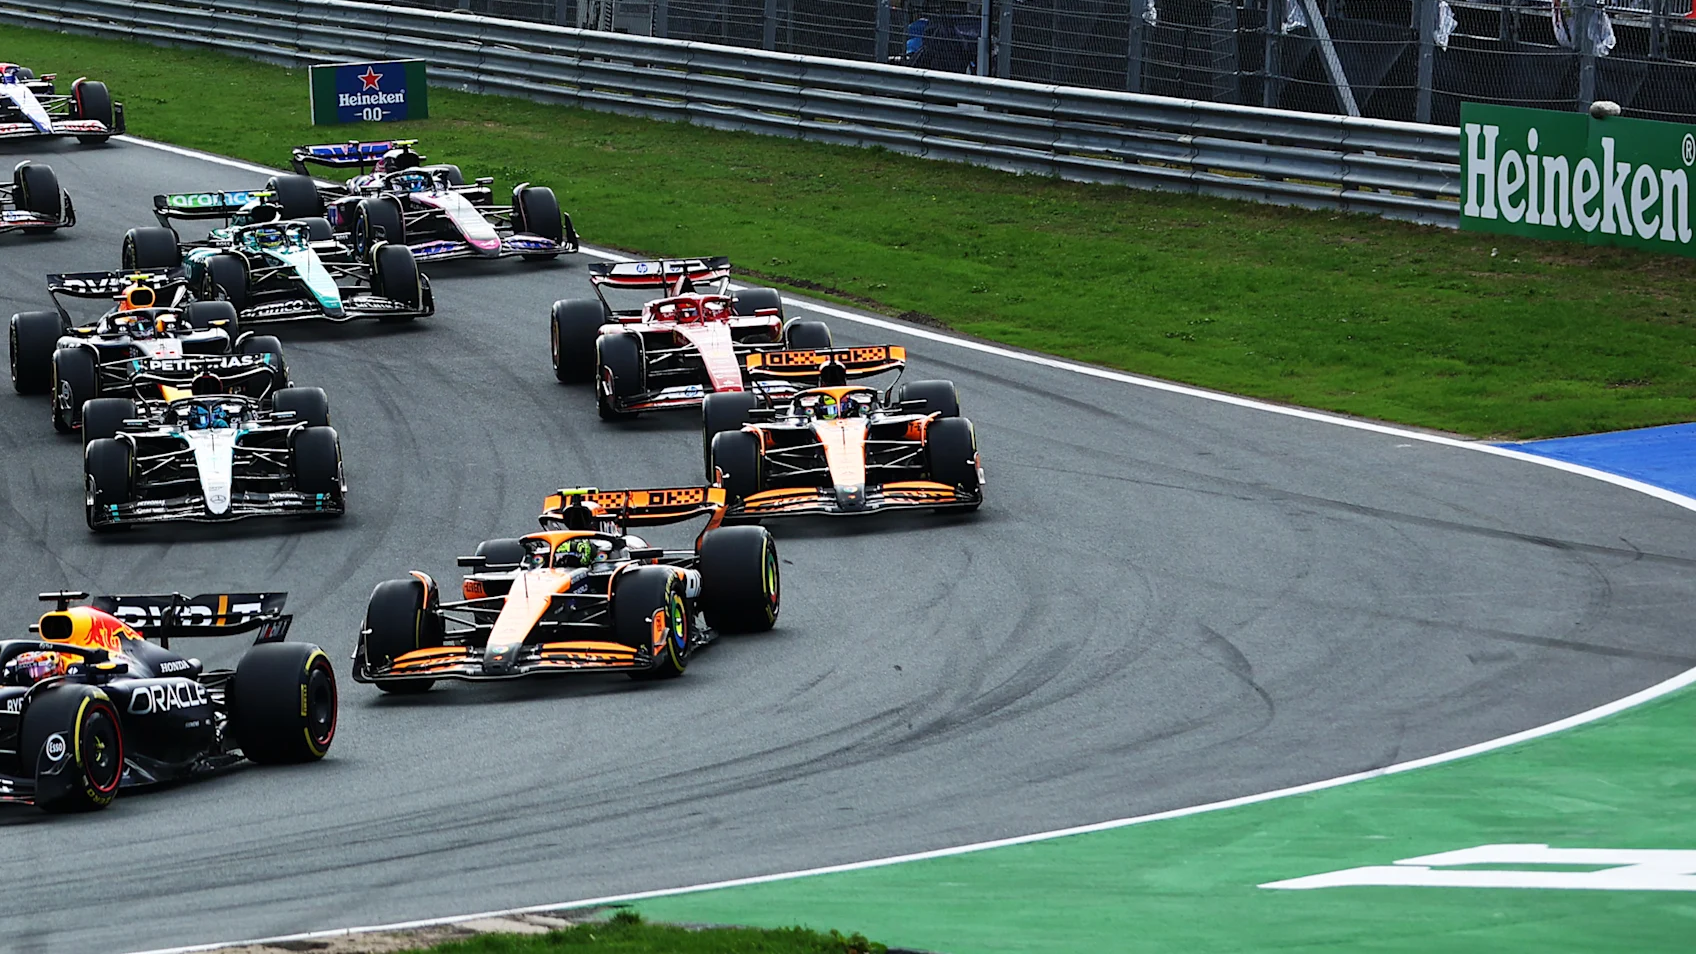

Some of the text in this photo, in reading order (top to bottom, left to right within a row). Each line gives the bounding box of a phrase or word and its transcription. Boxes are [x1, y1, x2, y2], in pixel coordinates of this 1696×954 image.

[338, 93, 404, 107] Heineken
[362, 107, 383, 121] 0.0
[1464, 123, 1693, 244] Heineken
[150, 355, 254, 371] PETRNAS
[160, 660, 190, 673] HONDA
[128, 681, 208, 715] ORACLE
